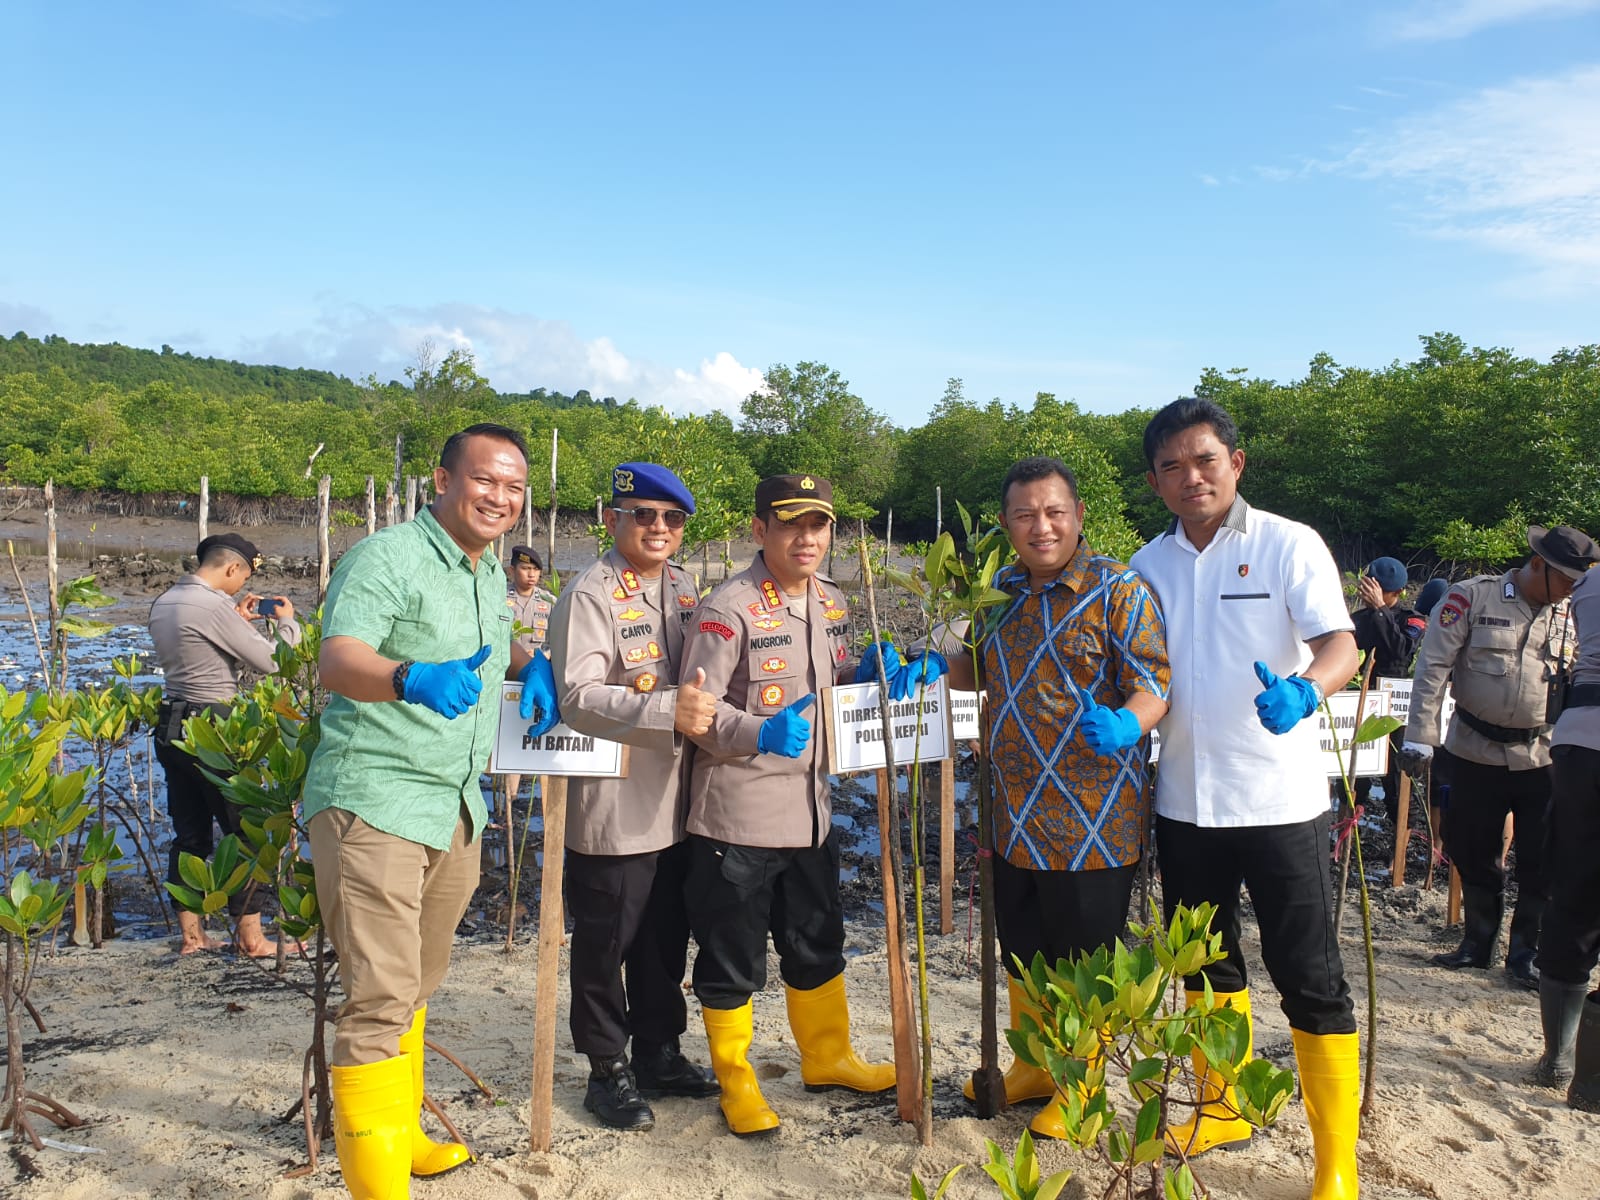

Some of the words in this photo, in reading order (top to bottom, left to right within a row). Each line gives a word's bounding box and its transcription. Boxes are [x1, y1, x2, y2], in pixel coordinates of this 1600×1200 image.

[703, 623, 731, 637] PELOPOR
[750, 634, 792, 650] NUGROHO
[522, 734, 542, 751] PN
[544, 735, 595, 753] BATAM
[855, 727, 892, 744] POLD
